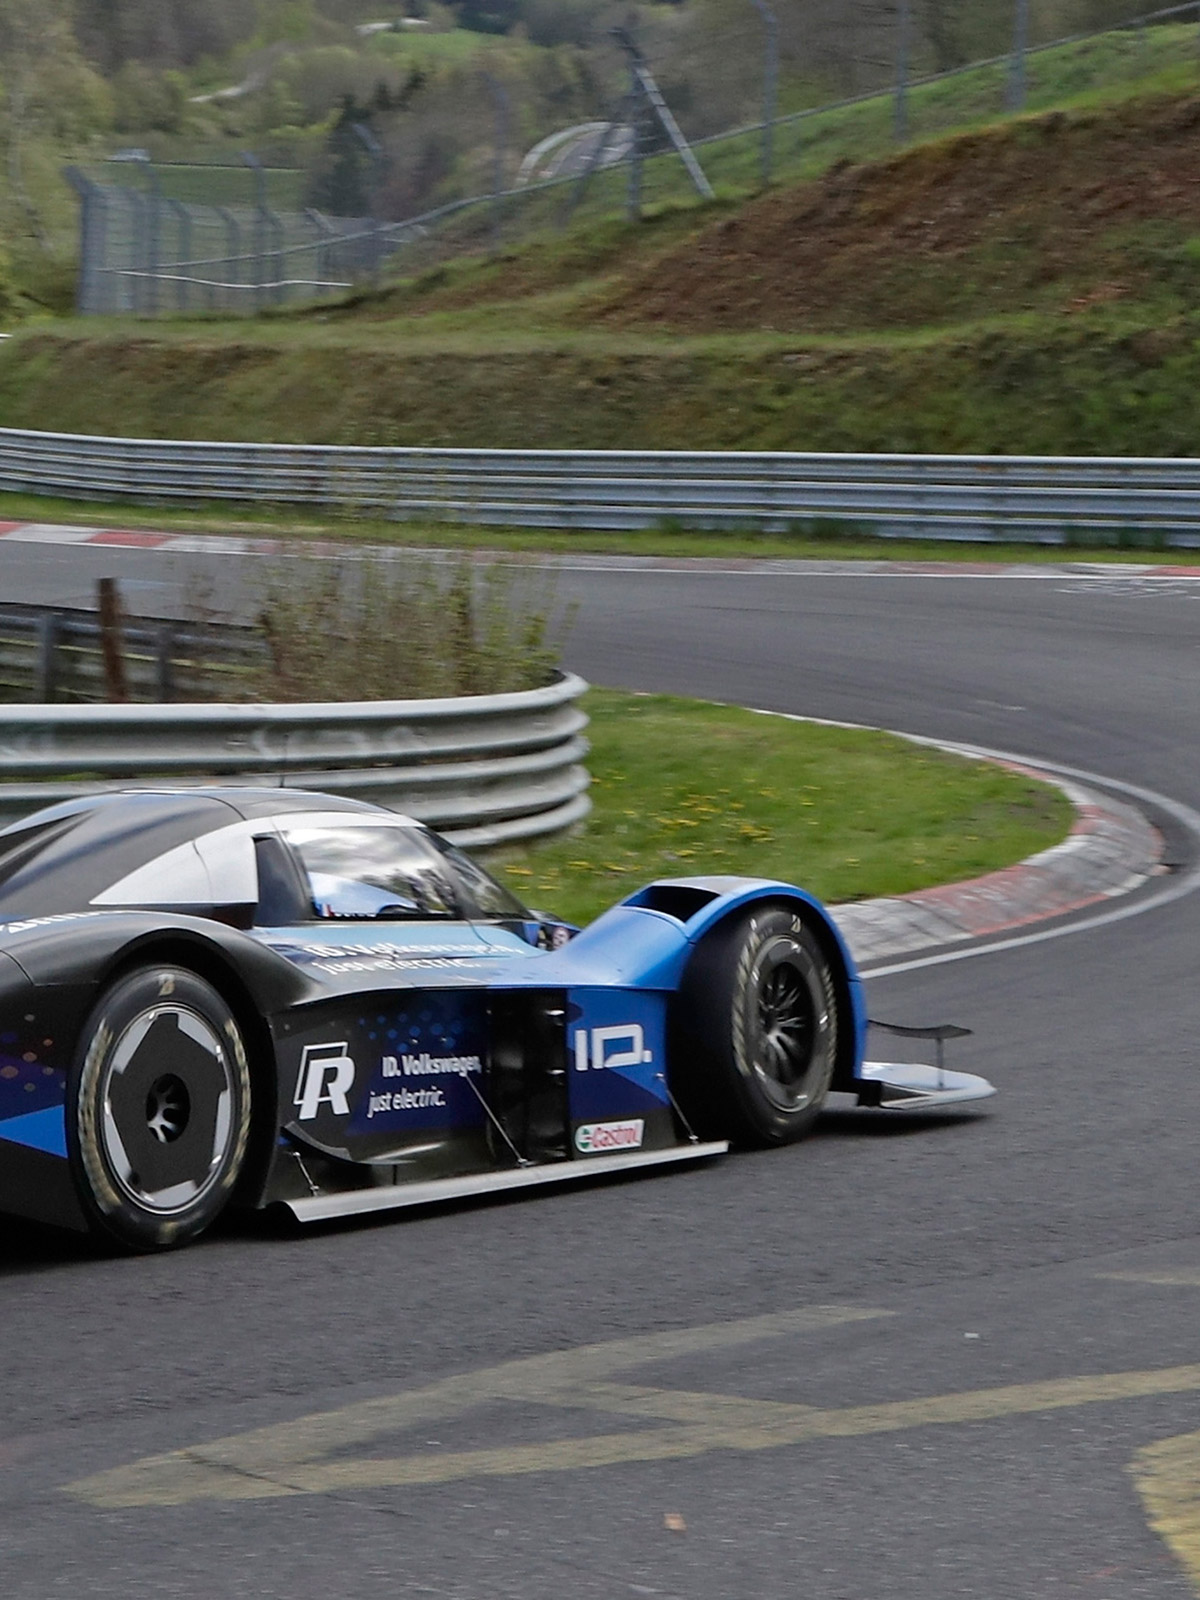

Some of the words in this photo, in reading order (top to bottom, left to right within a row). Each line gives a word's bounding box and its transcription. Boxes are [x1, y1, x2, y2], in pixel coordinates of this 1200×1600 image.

[311, 960, 375, 976] just
[298, 1055, 356, 1120] R
[366, 1090, 392, 1118] just
[393, 1086, 446, 1110] electric.
[587, 1124, 639, 1149] Castrol
